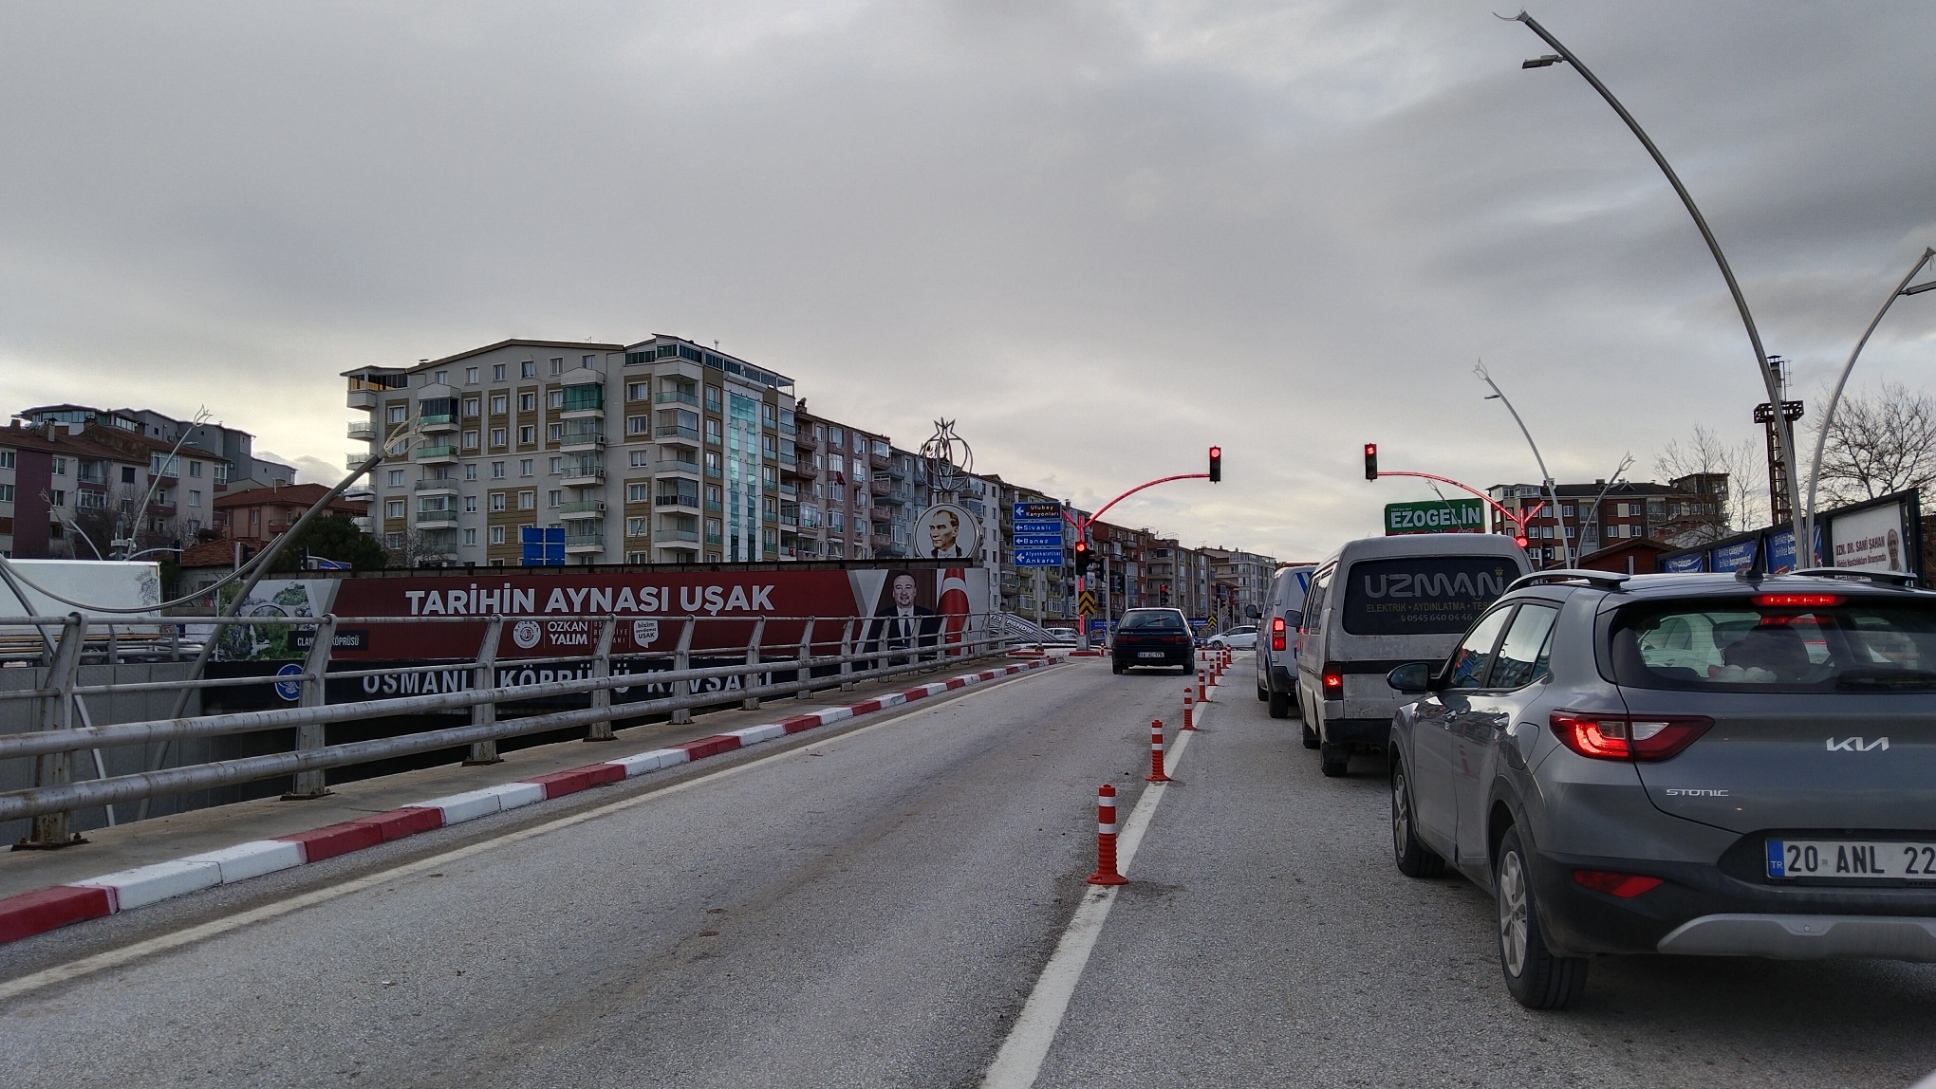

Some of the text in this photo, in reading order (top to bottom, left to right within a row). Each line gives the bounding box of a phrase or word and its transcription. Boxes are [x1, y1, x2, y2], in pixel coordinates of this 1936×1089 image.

[1390, 504, 1481, 528] EZOGELİN
[1869, 535, 1886, 553] ŞAHAN
[1364, 571, 1504, 600] UZMAN
[405, 583, 776, 616] TARİHİN AYNASI UŞAK
[1366, 602, 1407, 613] ELEKTRİK
[1413, 601, 1466, 612] AYDINLATMA
[1407, 614, 1429, 622] 0545
[1429, 613, 1446, 621] 640
[1461, 613, 1473, 621] 46
[549, 633, 588, 645] YALIM
[362, 669, 475, 695] OSMANL
[1666, 788, 1729, 797] STONIC
[1770, 860, 1783, 869] TR
[1786, 844, 1818, 872] 20
[1836, 845, 1885, 874] ANL
